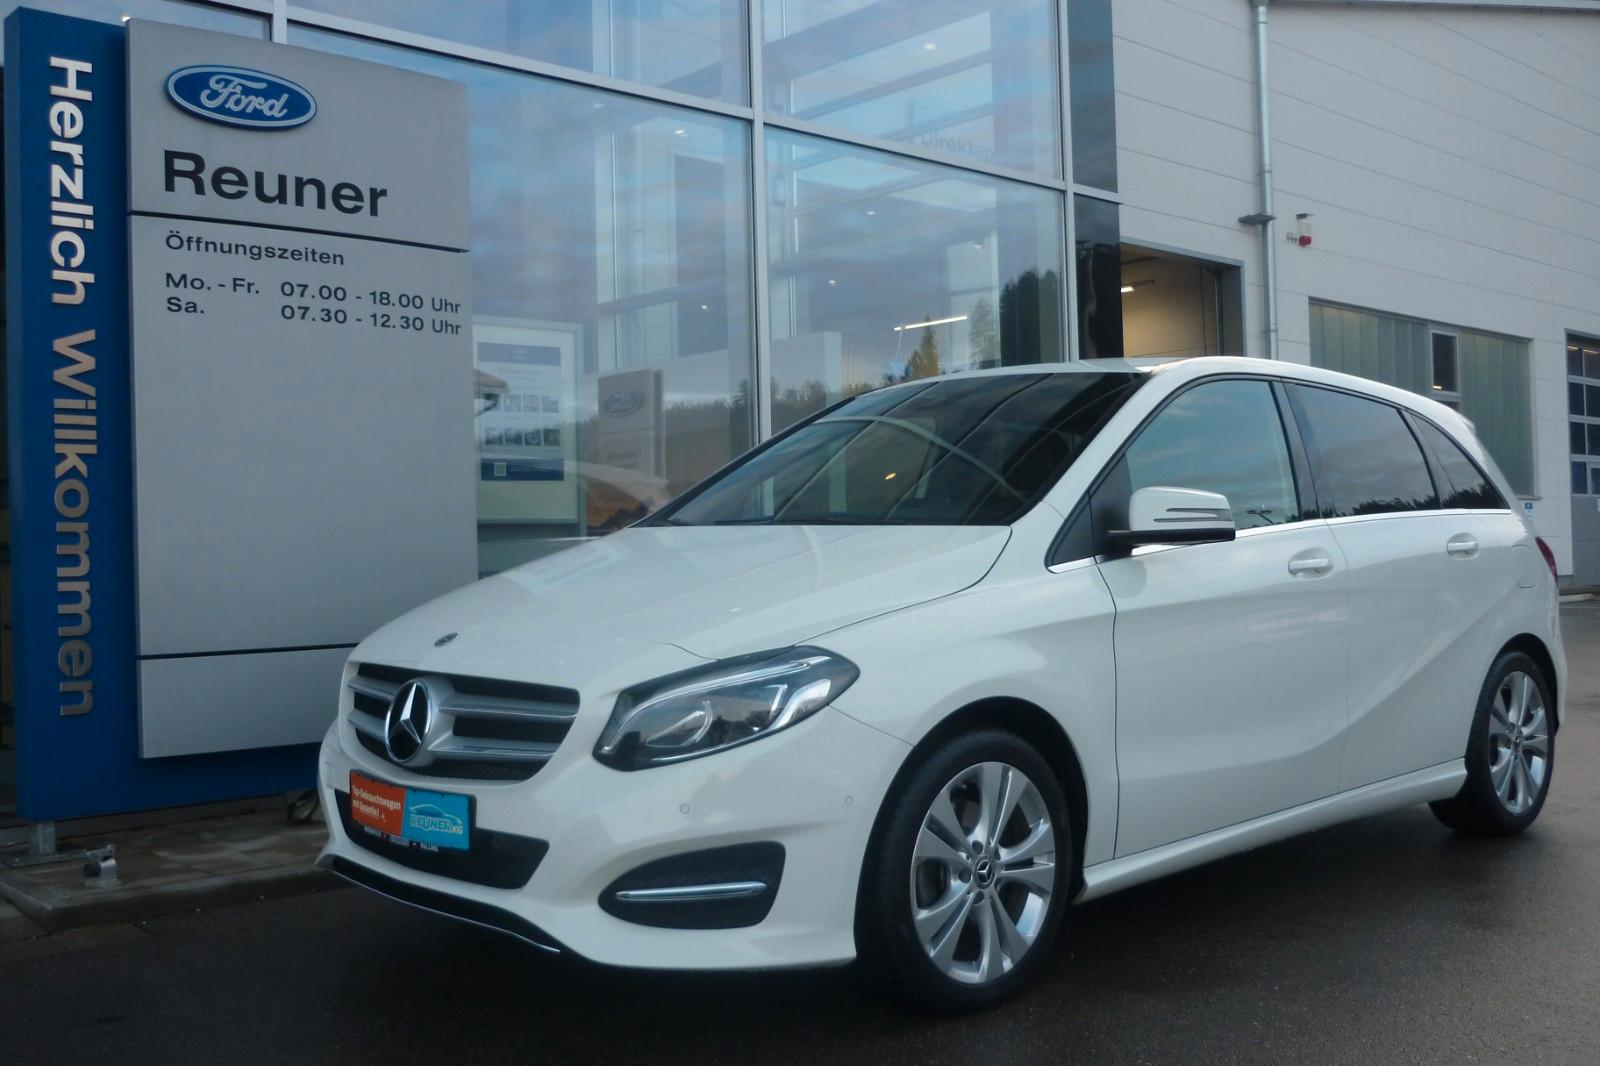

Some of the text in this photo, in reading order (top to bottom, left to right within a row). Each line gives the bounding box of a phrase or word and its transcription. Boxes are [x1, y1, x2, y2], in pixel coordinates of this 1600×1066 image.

[200, 75, 288, 119] Ford
[163, 149, 389, 218] Reuner
[165, 230, 345, 266] Öffnungszeiten
[166, 296, 205, 315] Sa.
[280, 304, 347, 325] 07.30
[369, 314, 424, 332] 12.30
[431, 318, 461, 336] Uhr
[280, 281, 347, 302] 07.00
[369, 290, 424, 310] 18.00
[431, 297, 461, 315] Uhr
[48, 55, 98, 717] Herzlich Willkommen
